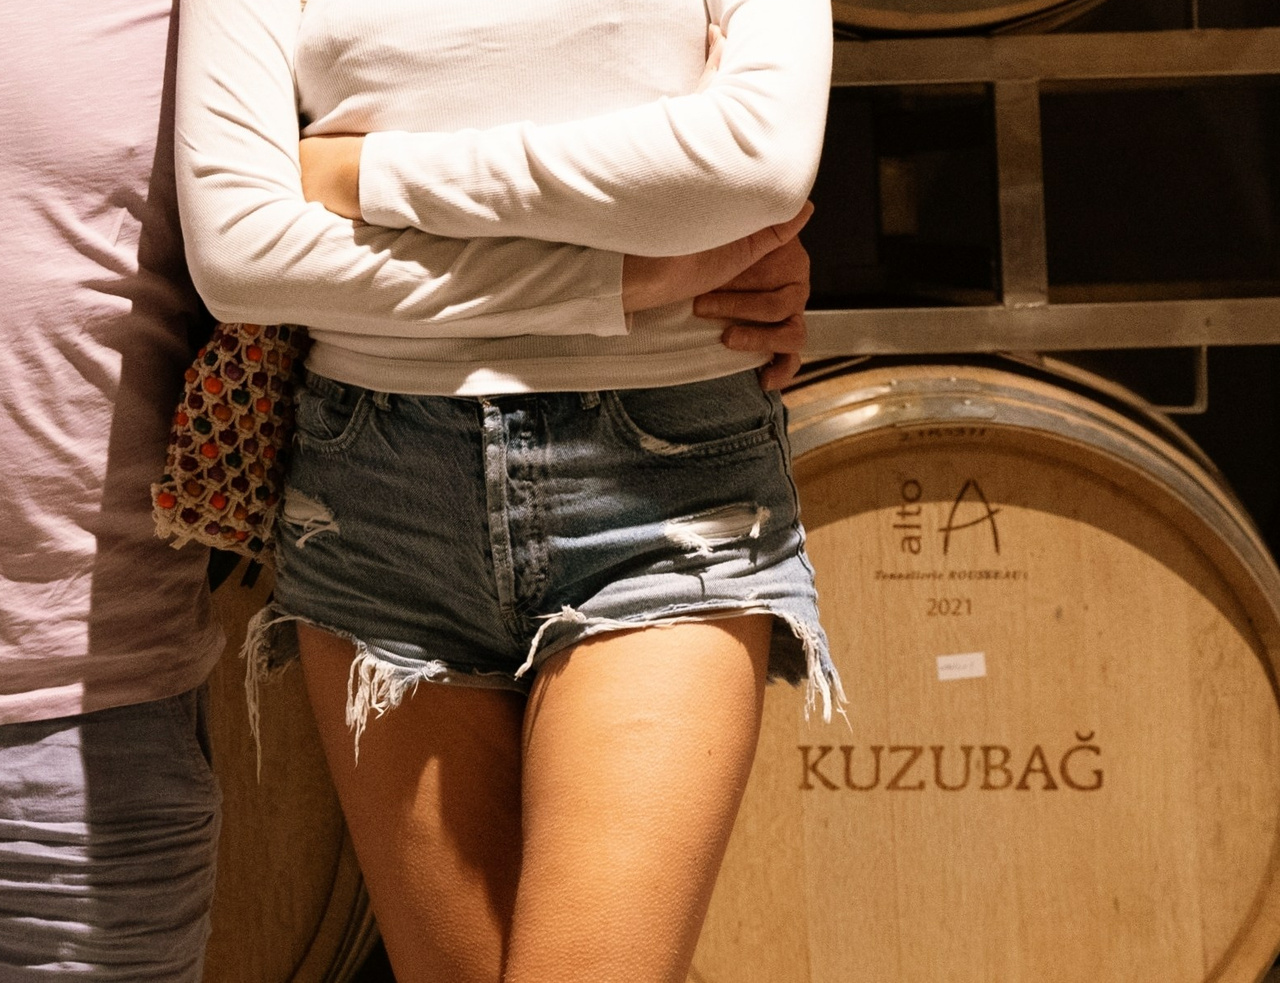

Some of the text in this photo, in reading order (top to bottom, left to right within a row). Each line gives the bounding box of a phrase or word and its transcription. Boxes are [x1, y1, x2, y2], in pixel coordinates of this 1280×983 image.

[893, 479, 922, 555] alto
[926, 598, 972, 616] 2021
[797, 731, 1105, 792] KUZUBAĞ
